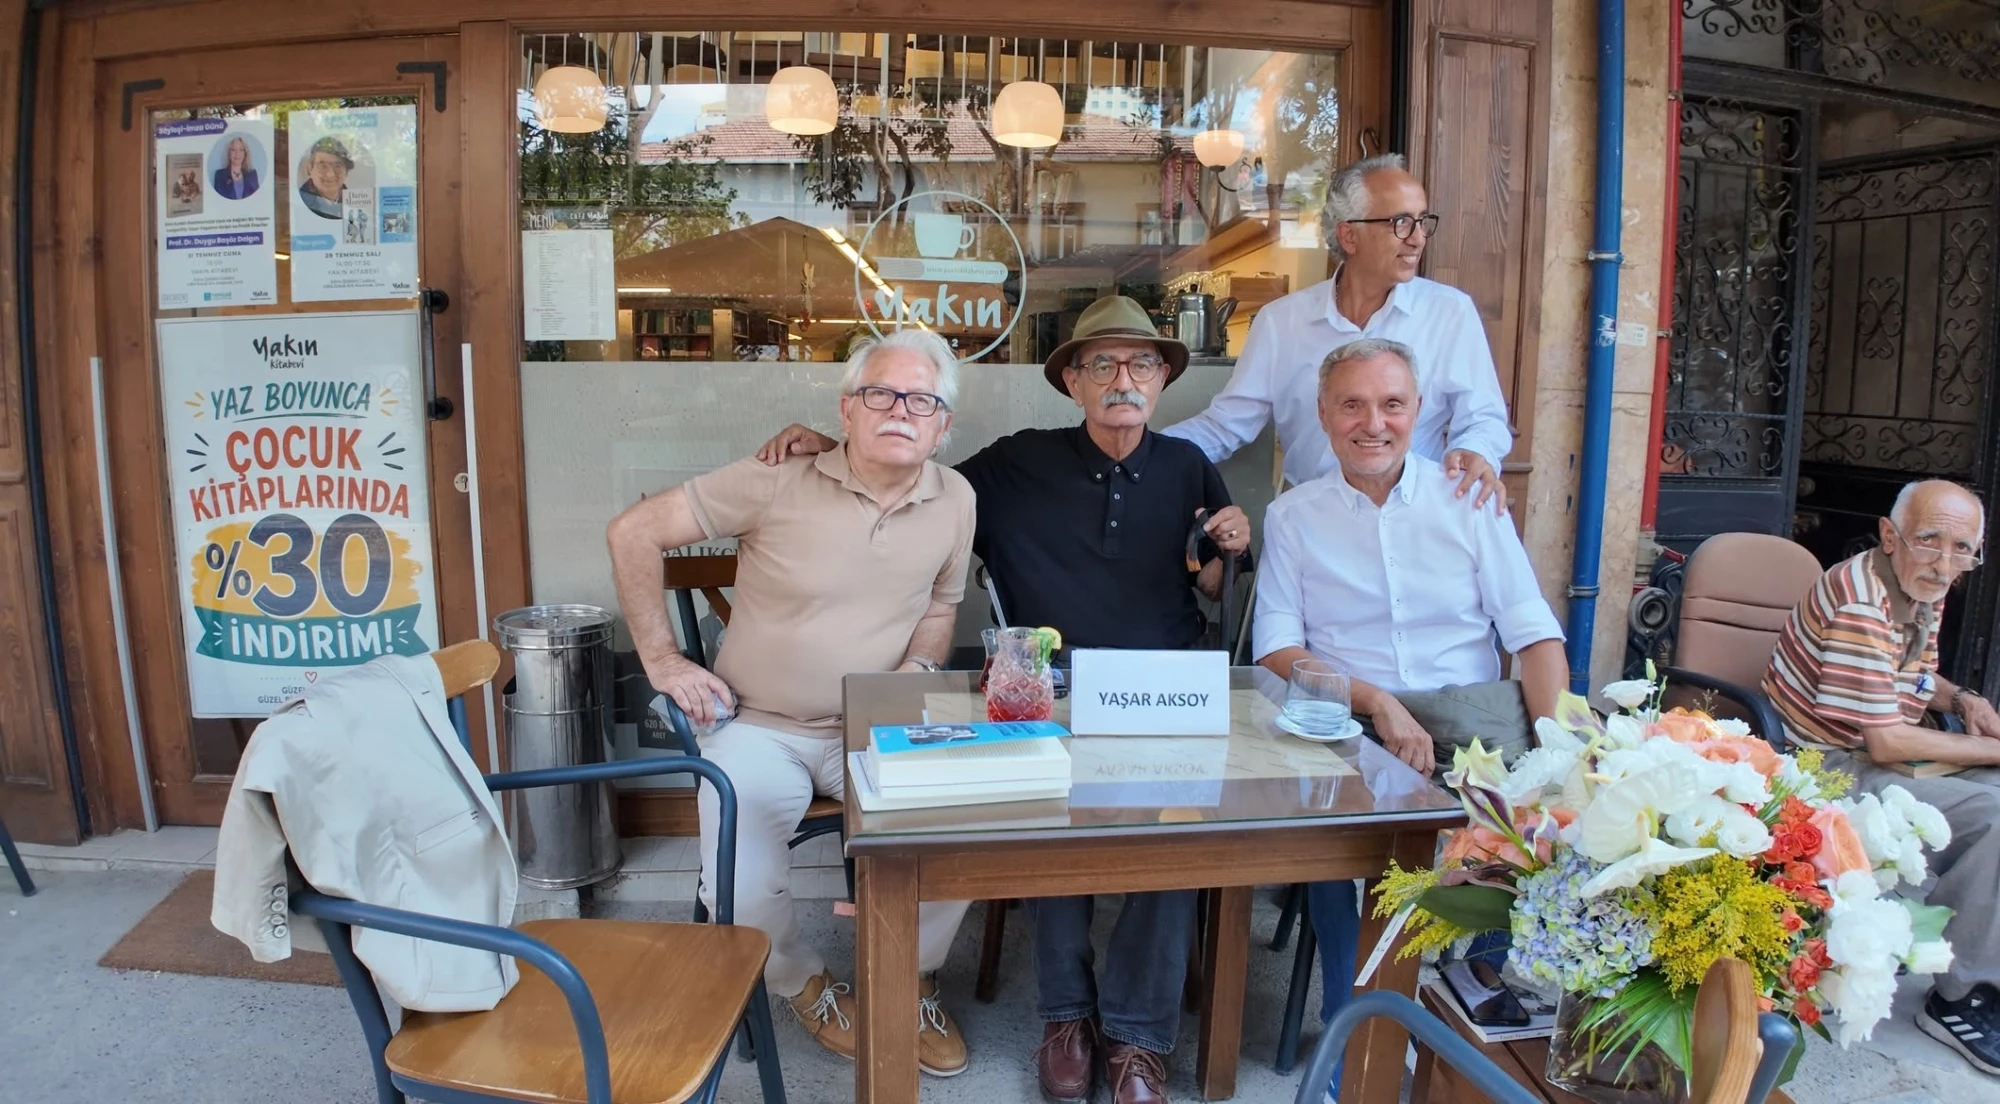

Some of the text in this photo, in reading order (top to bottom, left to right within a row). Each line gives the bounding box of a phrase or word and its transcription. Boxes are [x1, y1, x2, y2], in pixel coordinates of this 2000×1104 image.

[205, 122, 224, 131] Günü
[168, 238, 183, 247] Prof.
[184, 238, 194, 246] Dr.
[194, 237, 216, 247] Duygu
[874, 284, 1002, 333] Yakın
[252, 334, 318, 361] Yakın
[211, 381, 371, 420] YAZ BOYUNCA
[225, 425, 363, 481] ÇOCUK
[189, 475, 411, 523] KİTAPLARINDA
[205, 513, 392, 617] %30
[230, 618, 394, 659] İNDİRİM!
[258, 695, 283, 704] GÜZEL
[282, 685, 305, 694] GÜZE
[1098, 692, 1209, 709] YAŞAR AKSOY
